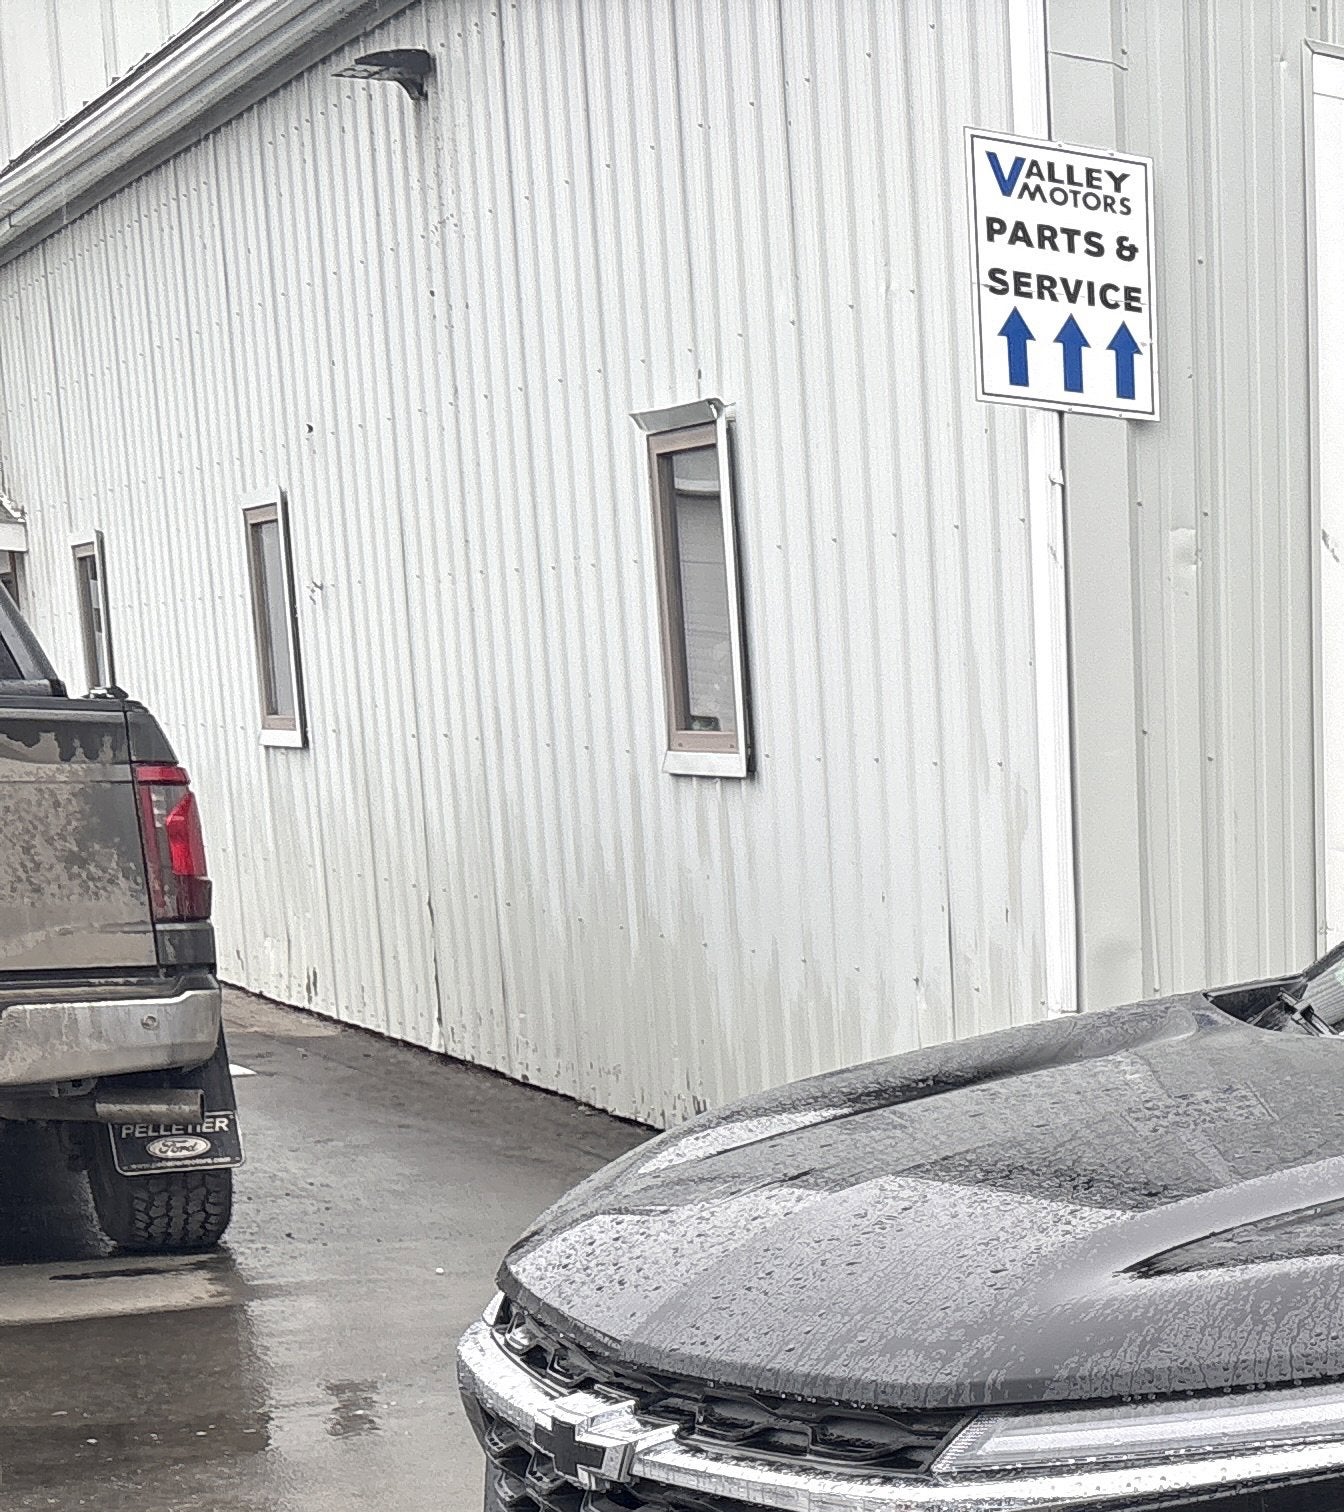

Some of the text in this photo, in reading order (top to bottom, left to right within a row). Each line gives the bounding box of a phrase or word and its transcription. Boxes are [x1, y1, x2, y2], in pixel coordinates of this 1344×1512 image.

[985, 150, 1130, 197] VALLEY
[1017, 182, 1132, 216] MOTORS
[986, 216, 1139, 262] PARTS &
[987, 267, 1143, 313] SERVICE
[159, 1139, 198, 1154] Ford
